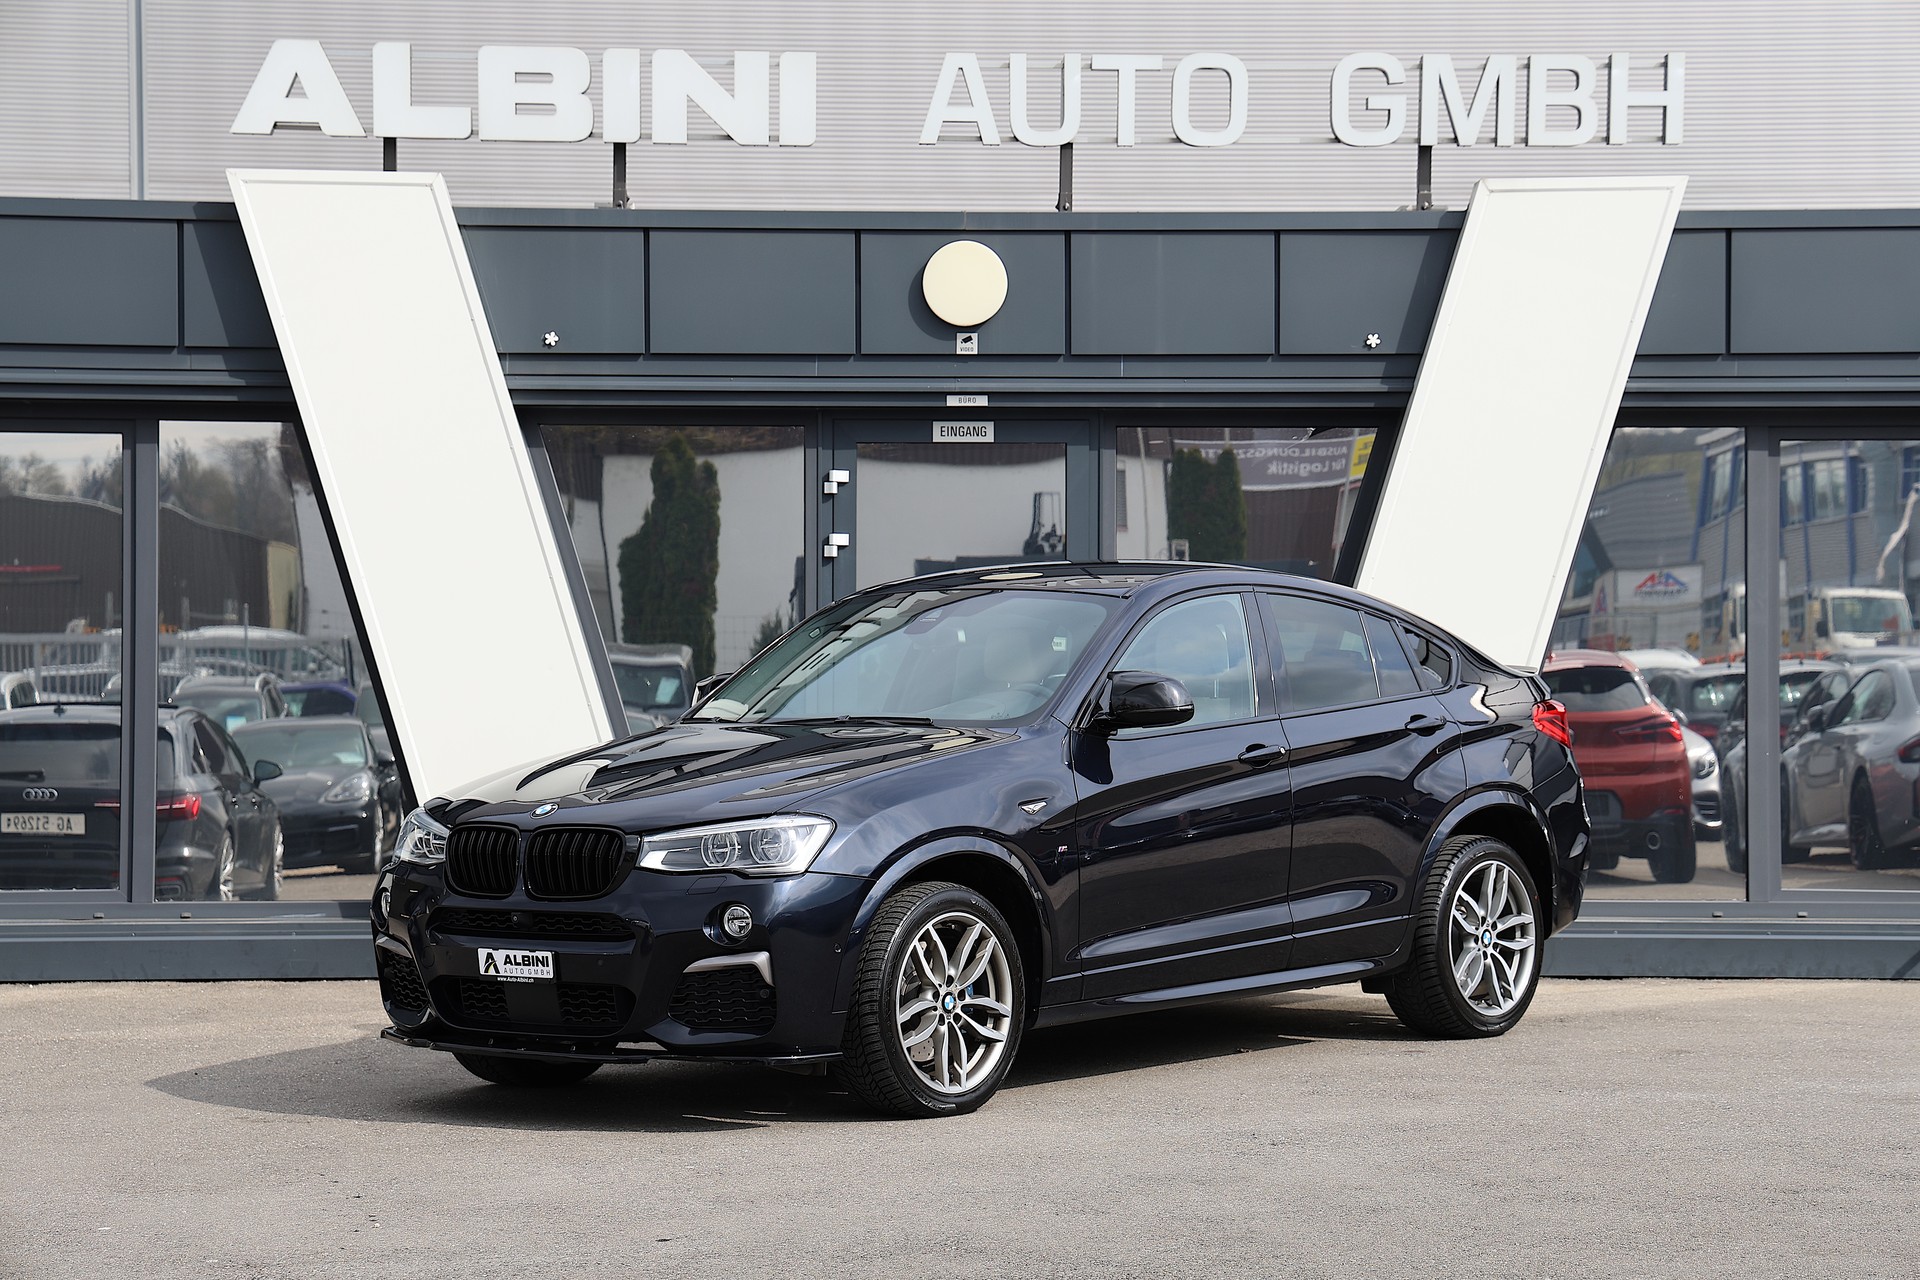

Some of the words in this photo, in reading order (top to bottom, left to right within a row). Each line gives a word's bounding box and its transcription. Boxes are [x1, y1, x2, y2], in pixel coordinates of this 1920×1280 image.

[230, 38, 817, 147] ALBINI
[918, 51, 1249, 147] AUTO
[1330, 51, 1687, 147] GMBH
[958, 396, 977, 404] BÜRO
[939, 425, 988, 437] EINGANG
[503, 954, 550, 967] ALBINI
[527, 968, 551, 976] GMBH
